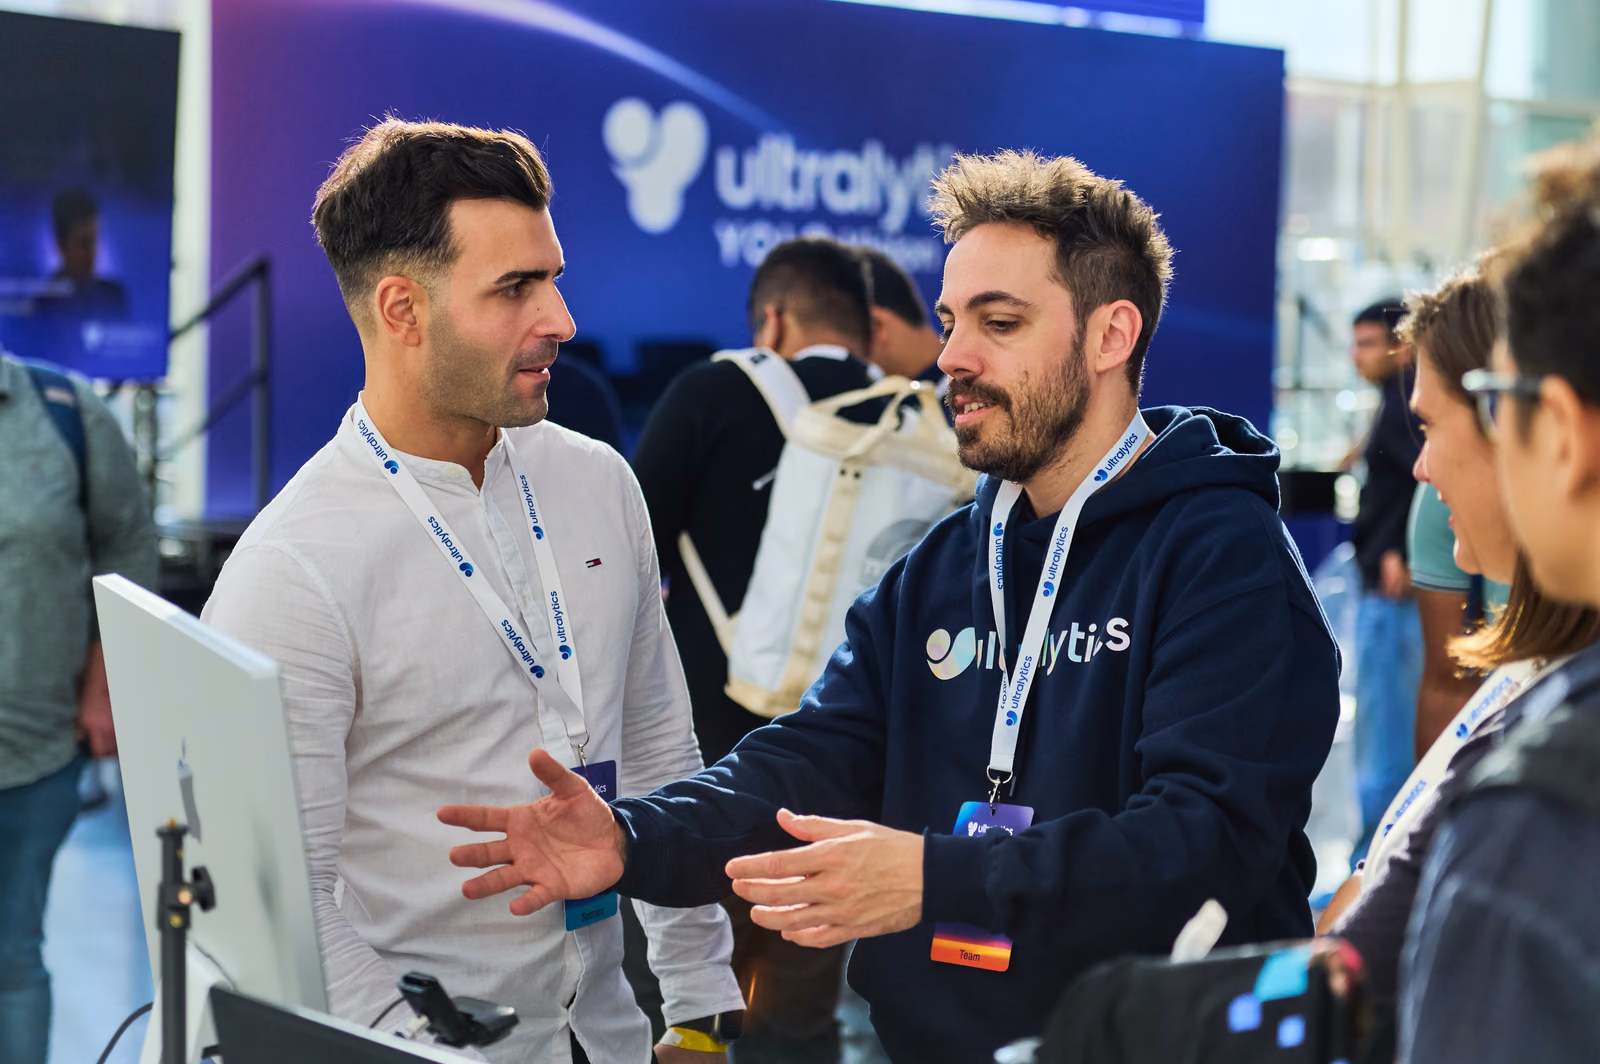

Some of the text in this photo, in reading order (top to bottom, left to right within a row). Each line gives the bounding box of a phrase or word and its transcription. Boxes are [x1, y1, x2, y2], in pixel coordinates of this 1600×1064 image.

[358, 419, 388, 461] ultralytics
[1106, 432, 1139, 471] ultralytics
[519, 474, 539, 524] ultralytics
[427, 516, 463, 563] ultralytics
[1047, 526, 1069, 580] ultralytics
[550, 591, 567, 643] ultralytics
[501, 619, 535, 666] ultralytics
[1011, 655, 1033, 709] ultralytics
[959, 949, 981, 962] Team
